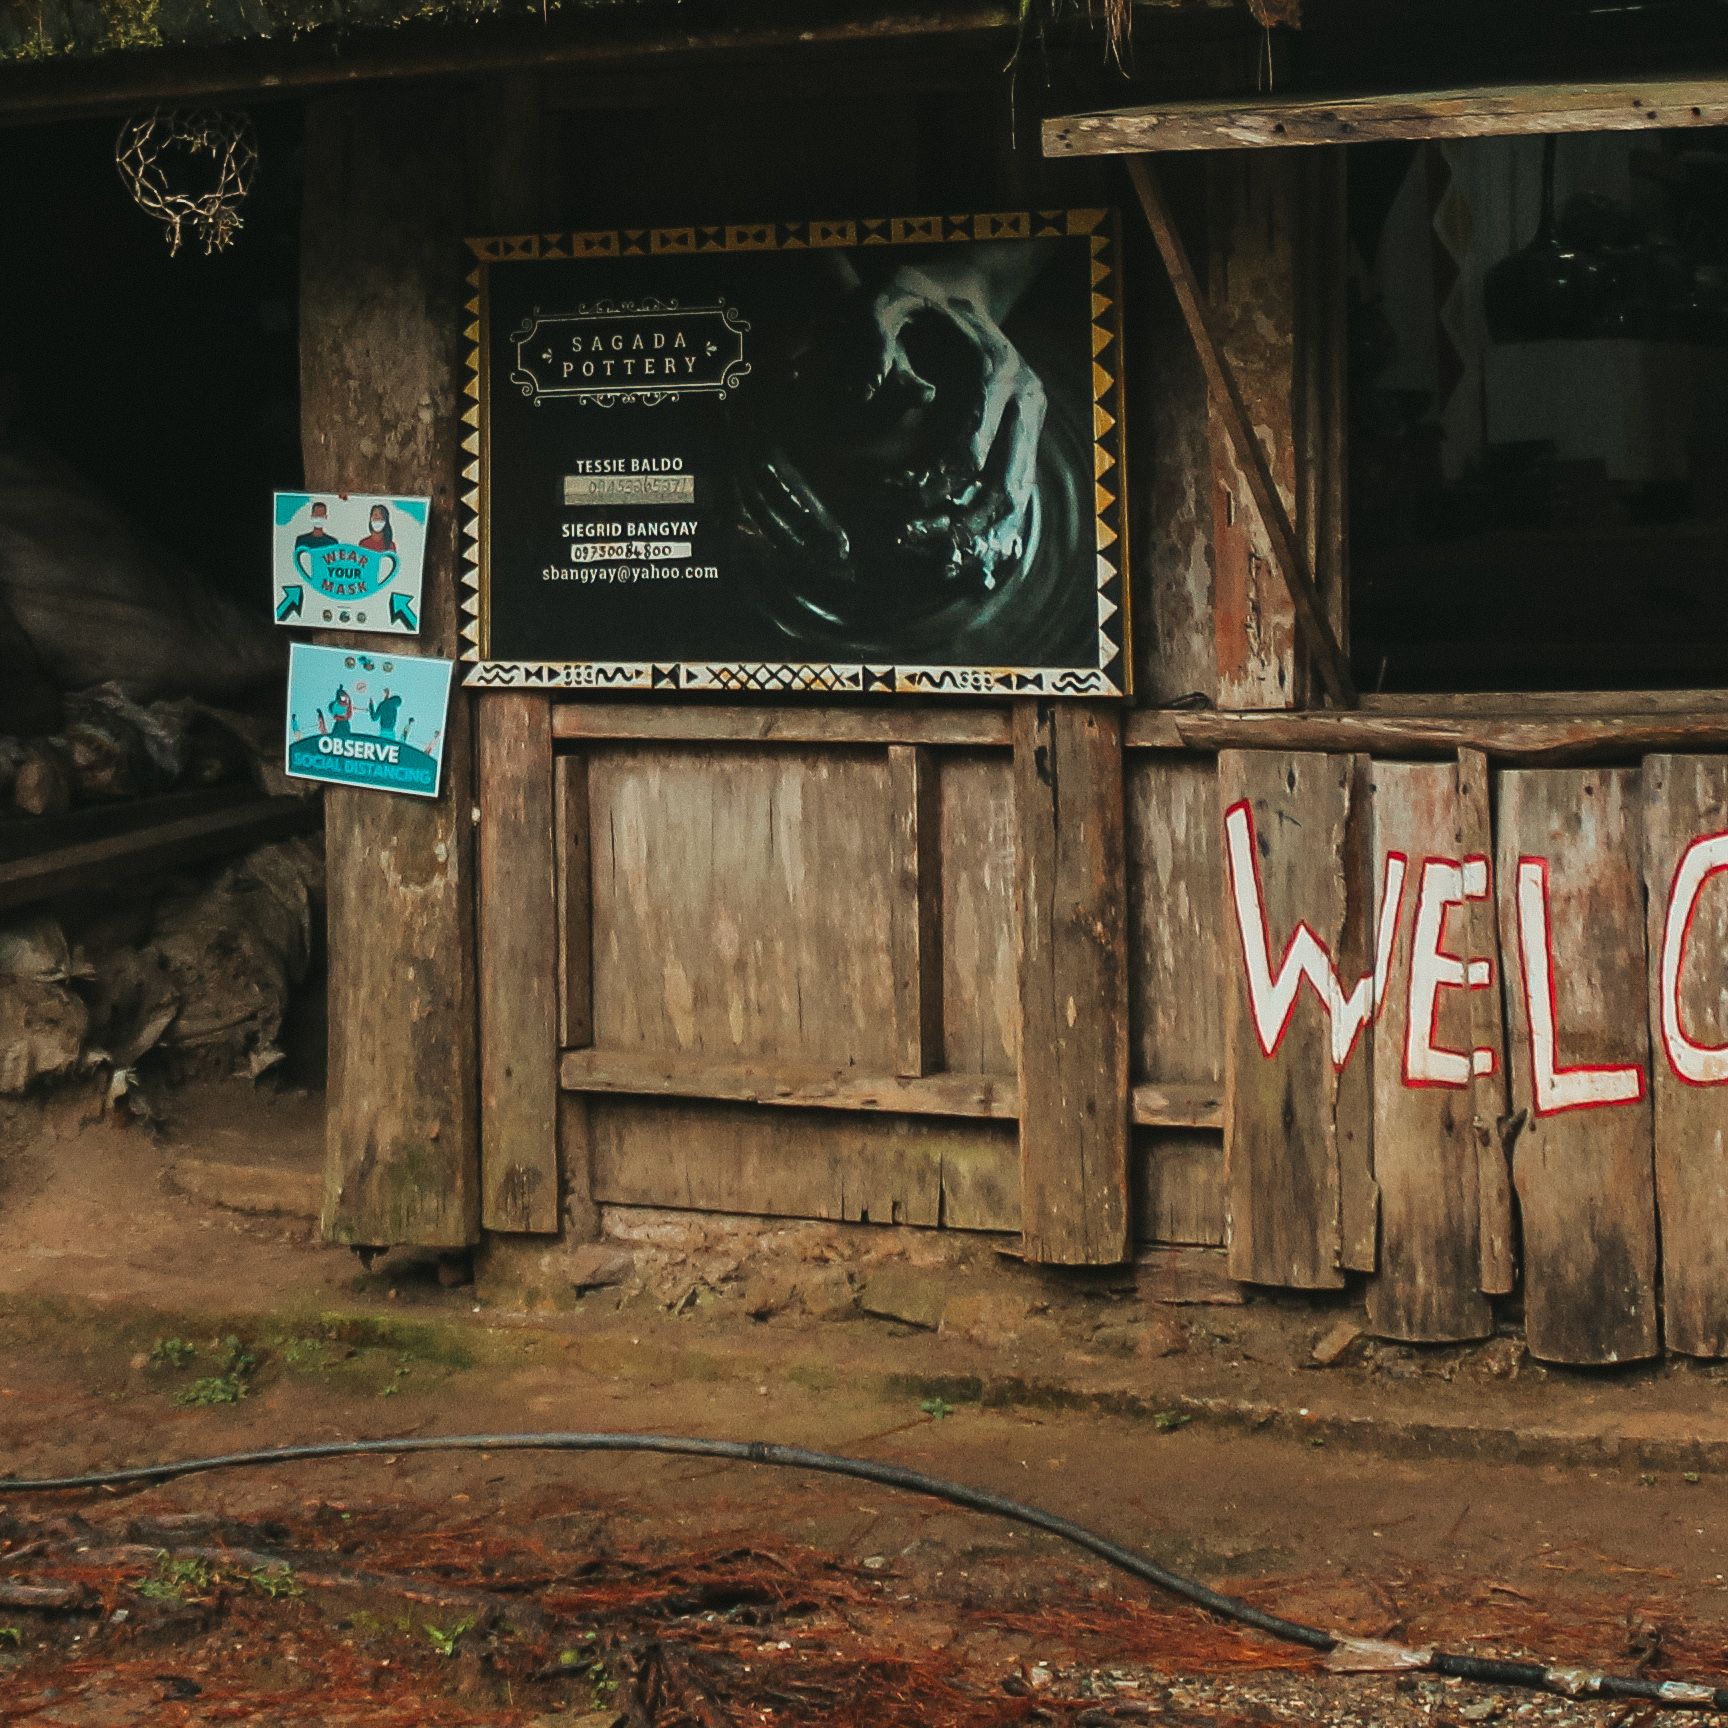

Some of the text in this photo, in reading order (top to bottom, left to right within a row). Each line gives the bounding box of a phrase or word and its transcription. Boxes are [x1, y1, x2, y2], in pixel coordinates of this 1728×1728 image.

[571, 332, 687, 352] SAGADA
[563, 357, 697, 377] POTTERY
[576, 458, 683, 473] TESSIE BALDO
[562, 522, 698, 538] SIEGRID BANGYAY
[322, 549, 369, 567] WEAR
[327, 566, 362, 580] YOUR
[542, 566, 718, 583] sbangyay@yahoo.com
[322, 579, 368, 595] MASK
[318, 736, 400, 764] OBSERVE
[293, 754, 431, 785] SOCIAL DISTANCING
